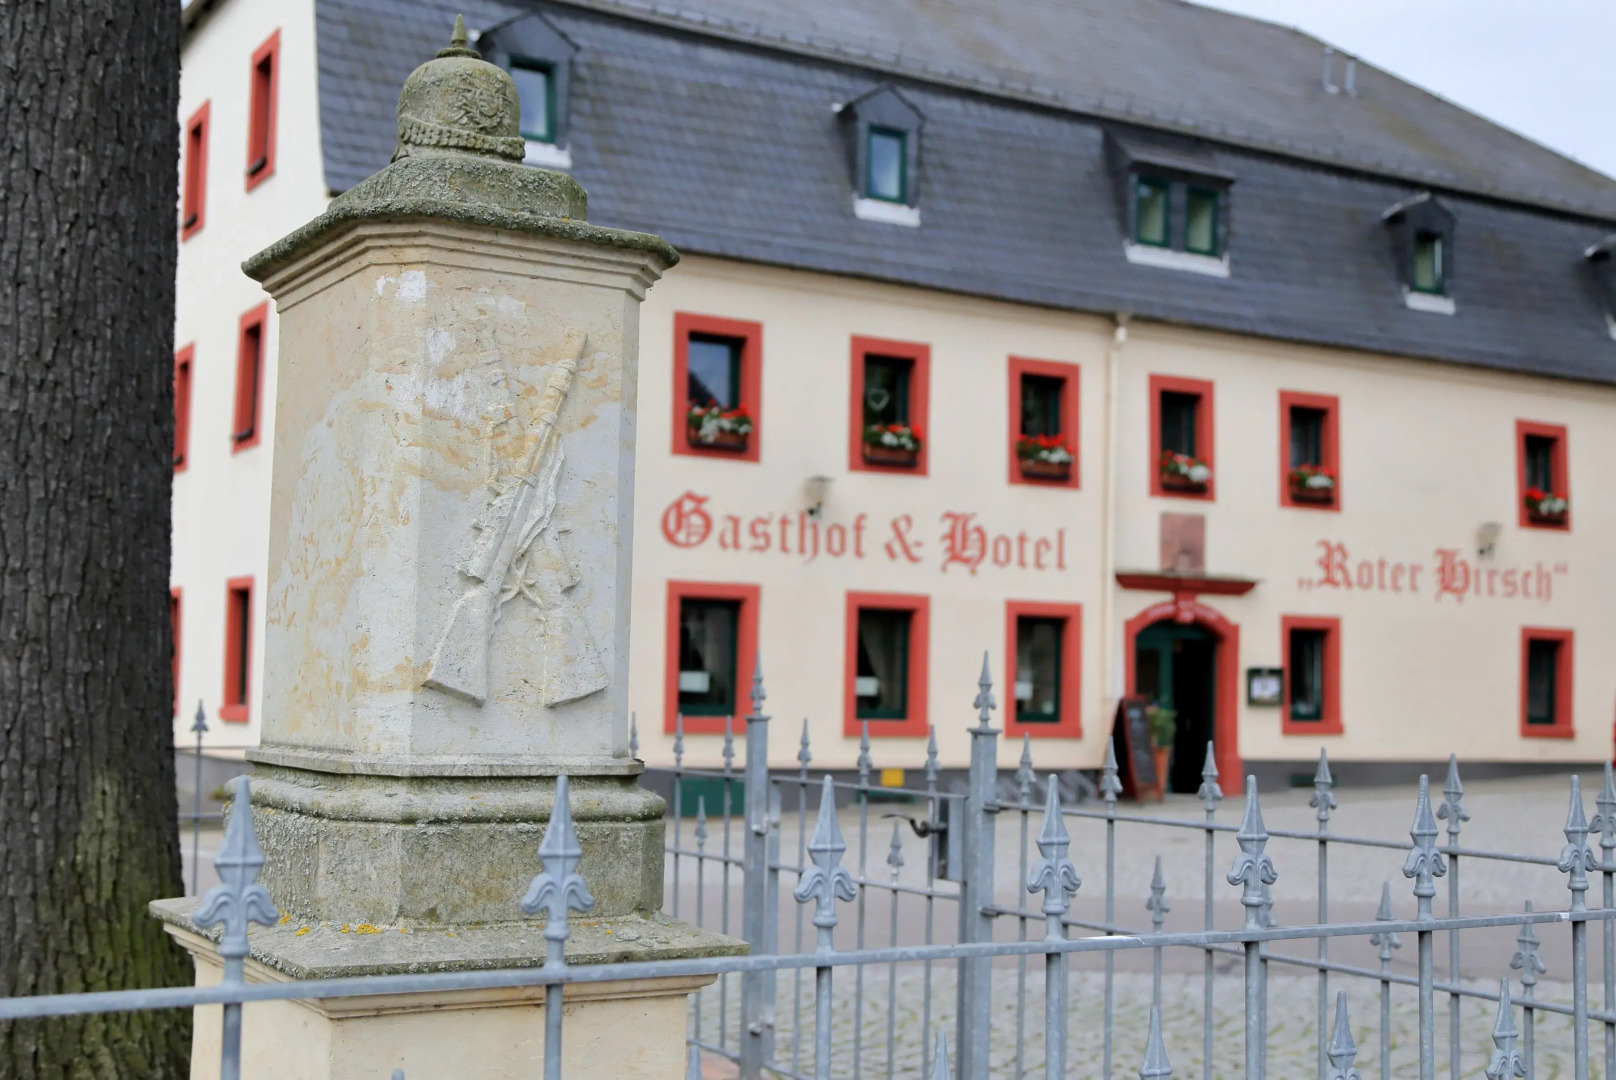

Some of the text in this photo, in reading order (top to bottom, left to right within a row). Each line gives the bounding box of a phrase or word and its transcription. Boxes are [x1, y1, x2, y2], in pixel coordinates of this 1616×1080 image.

[661, 491, 1067, 575] Gasthof & Hotel
